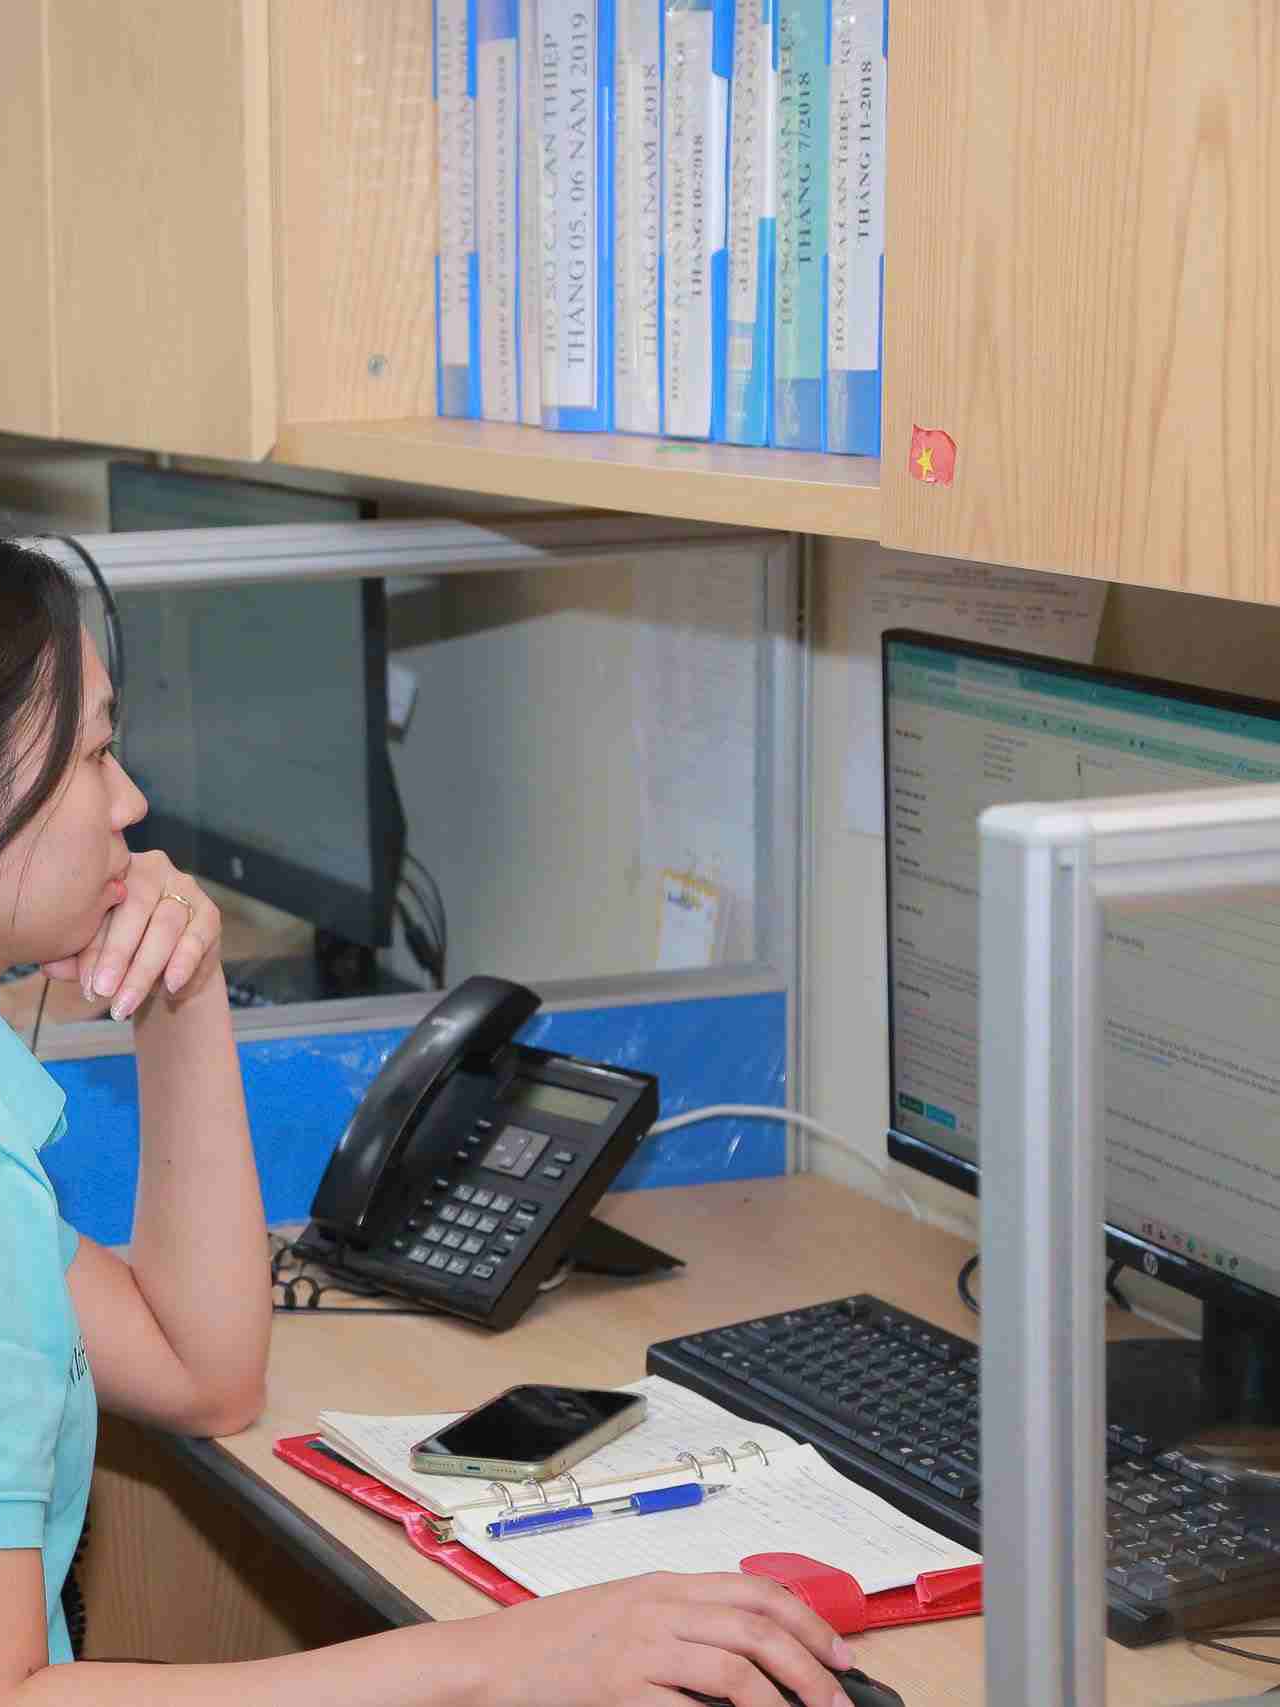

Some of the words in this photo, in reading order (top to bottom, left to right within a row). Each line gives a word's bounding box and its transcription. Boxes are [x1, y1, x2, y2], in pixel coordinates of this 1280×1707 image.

[568, 11, 588, 78] 2019
[641, 62, 658, 129] 2018
[796, 71, 813, 154] 7/2018
[856, 58, 872, 145] 11-2018
[567, 170, 587, 204] 06
[562, 261, 587, 369] THÁNG
